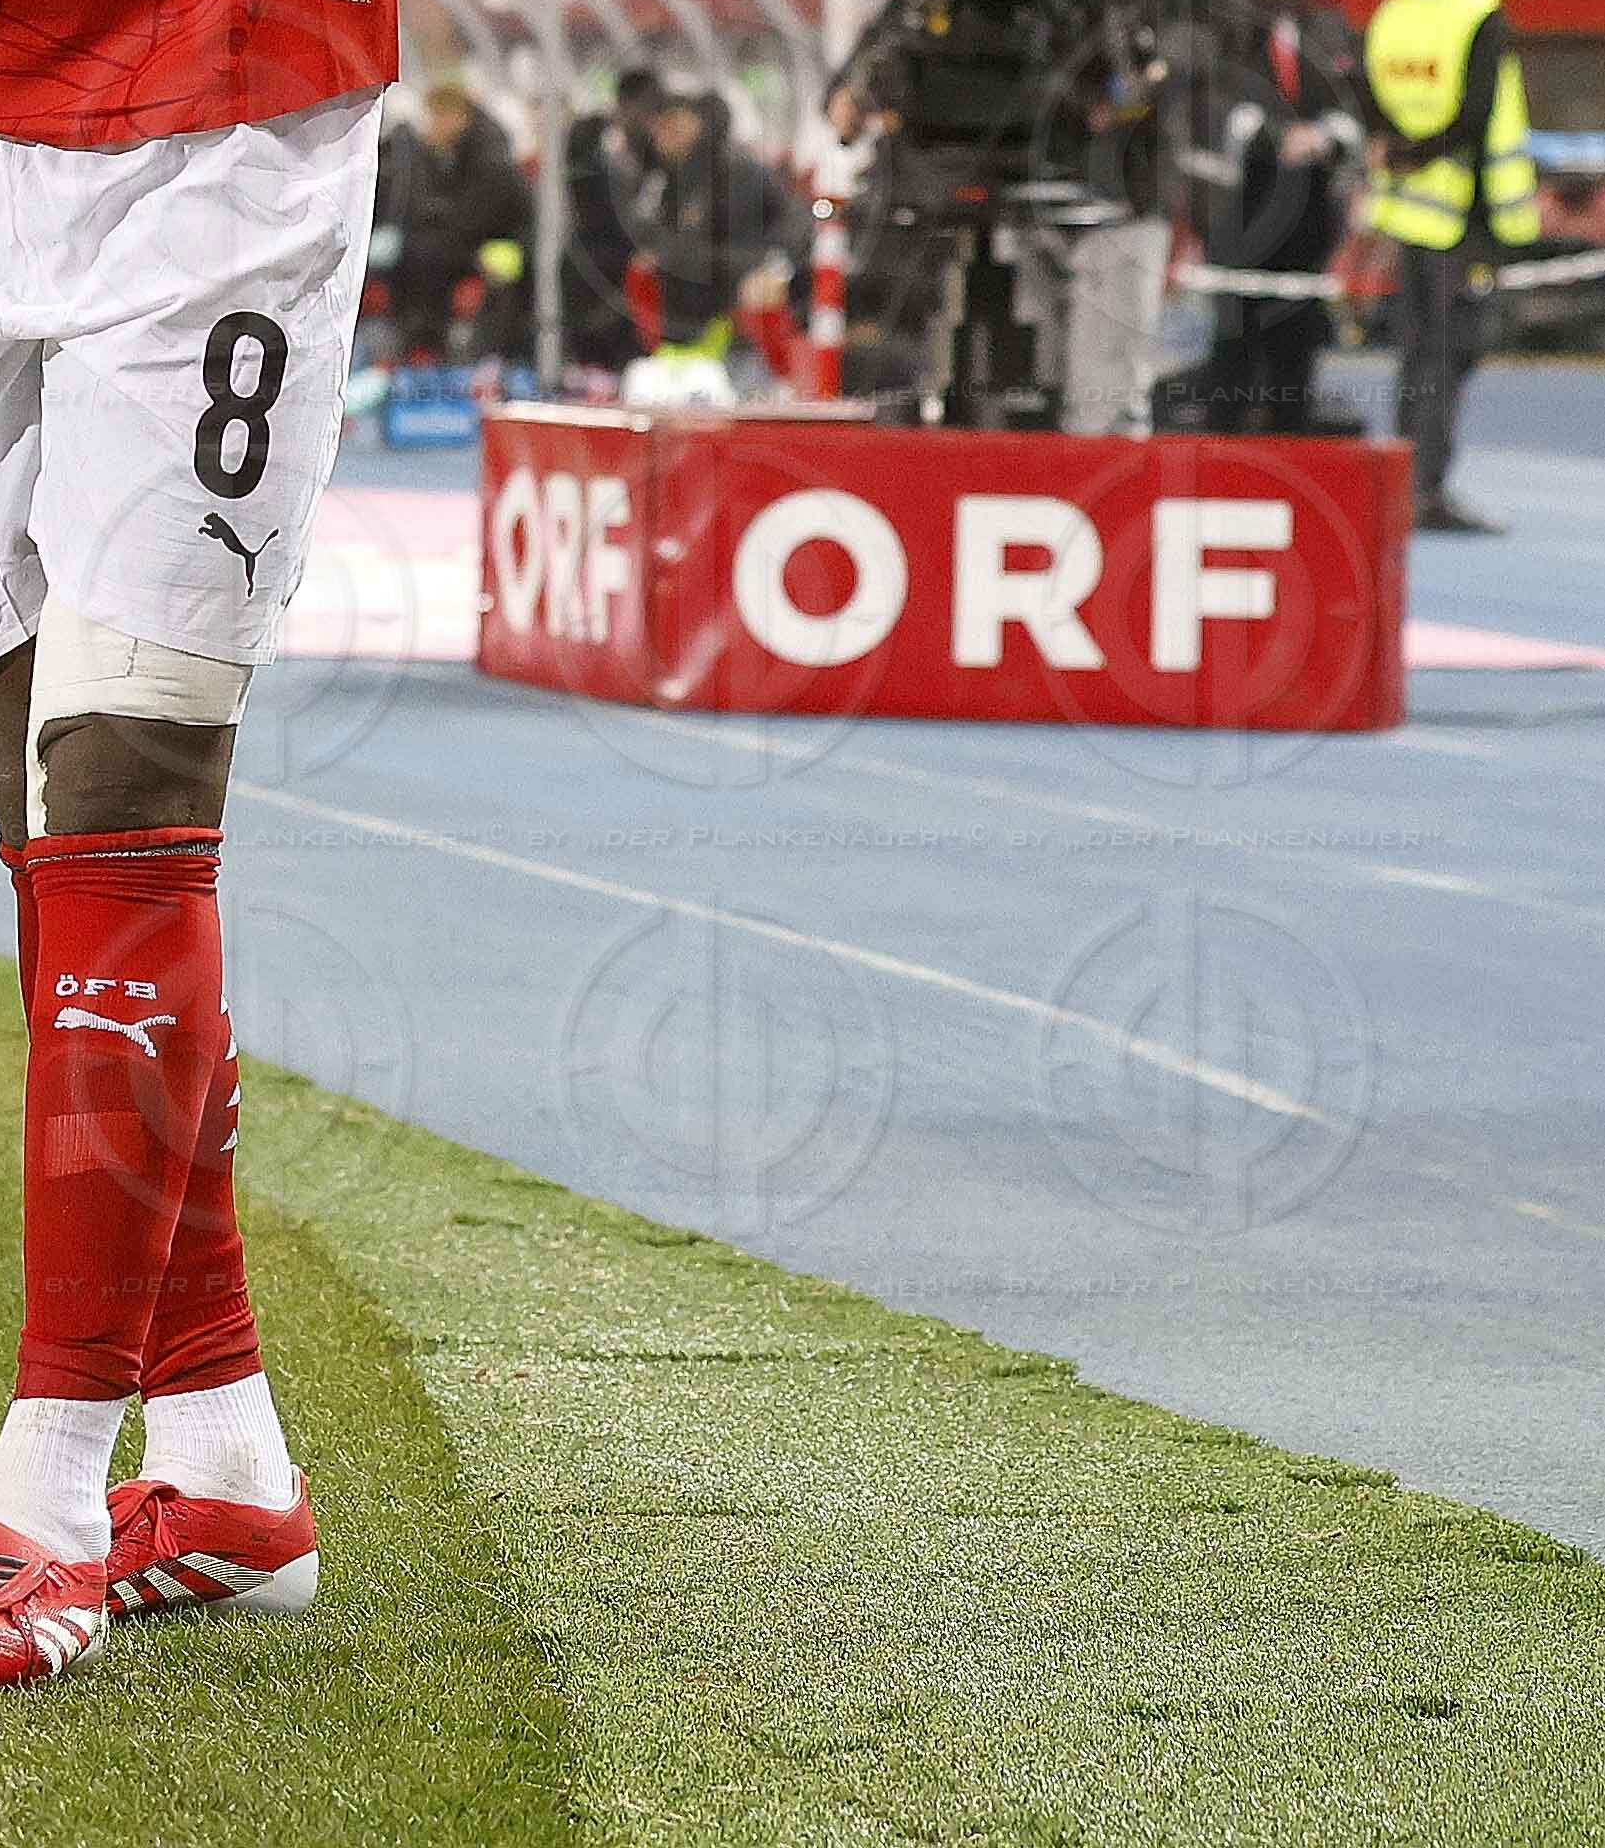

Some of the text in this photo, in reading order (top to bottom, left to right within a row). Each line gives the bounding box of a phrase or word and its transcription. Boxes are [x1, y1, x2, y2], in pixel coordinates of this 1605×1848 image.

[194, 312, 288, 499] 8
[491, 464, 633, 643] ORF
[732, 487, 1294, 673] ORF
[54, 973, 157, 1000] ÖFB
